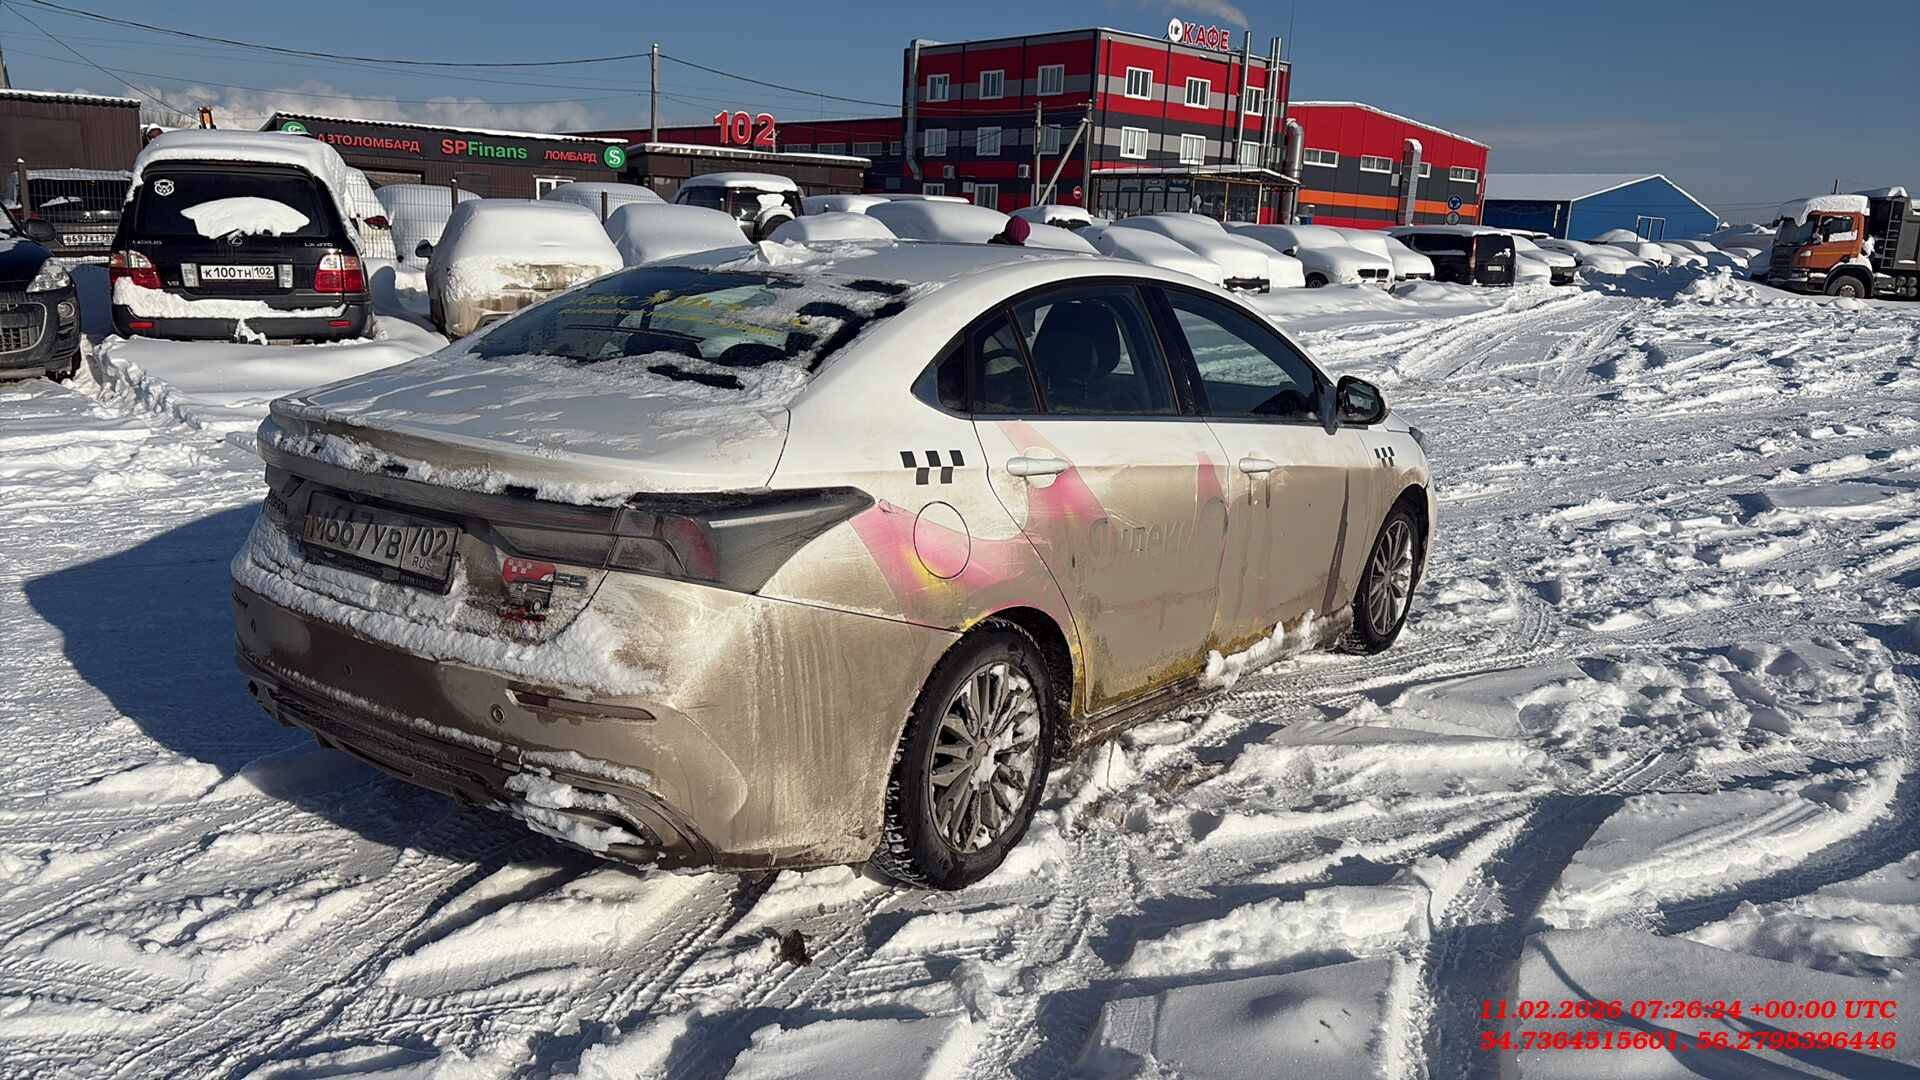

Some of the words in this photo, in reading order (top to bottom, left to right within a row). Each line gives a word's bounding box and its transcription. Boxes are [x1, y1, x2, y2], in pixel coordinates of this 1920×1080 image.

[1183, 22, 1230, 51] КАФЕ
[713, 109, 775, 146] 102
[441, 138, 529, 160] SPFinans
[543, 149, 598, 164] ЛОМБАРД
[411, 555, 434, 571] RUS
